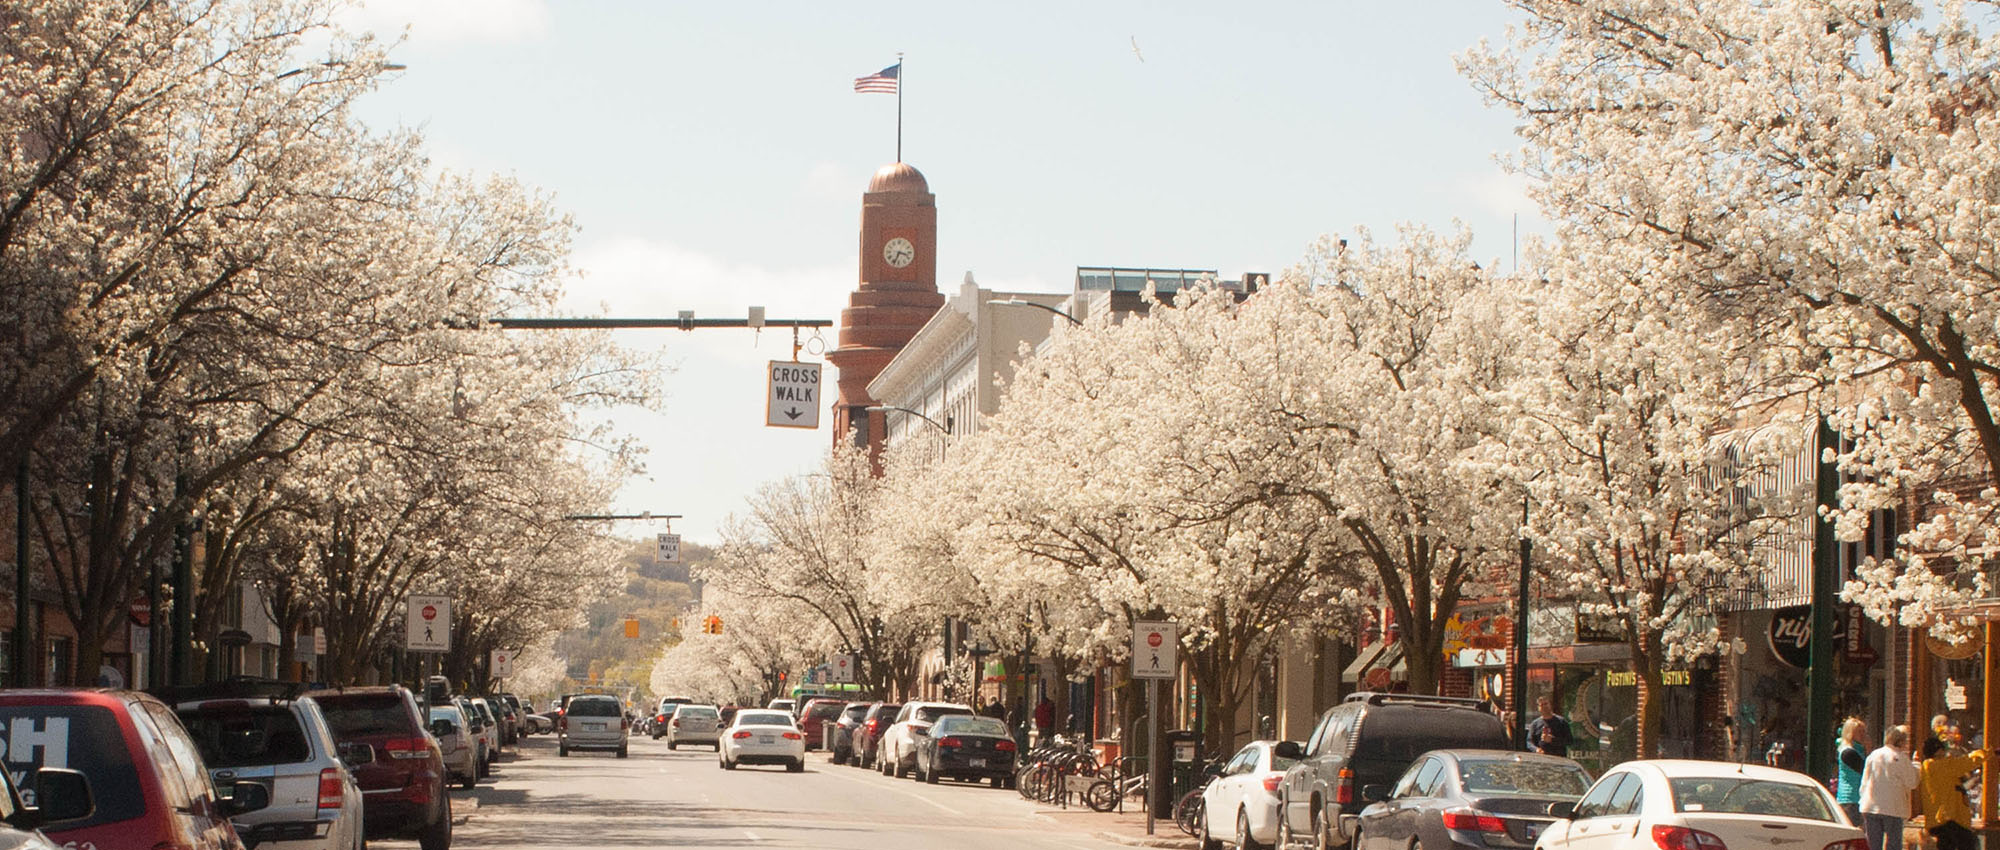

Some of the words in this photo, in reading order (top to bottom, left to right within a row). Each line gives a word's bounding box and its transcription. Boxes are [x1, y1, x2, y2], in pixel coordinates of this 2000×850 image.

[773, 367, 818, 384] CROSS
[776, 386, 812, 402] WALK
[658, 536, 679, 544] CROSS
